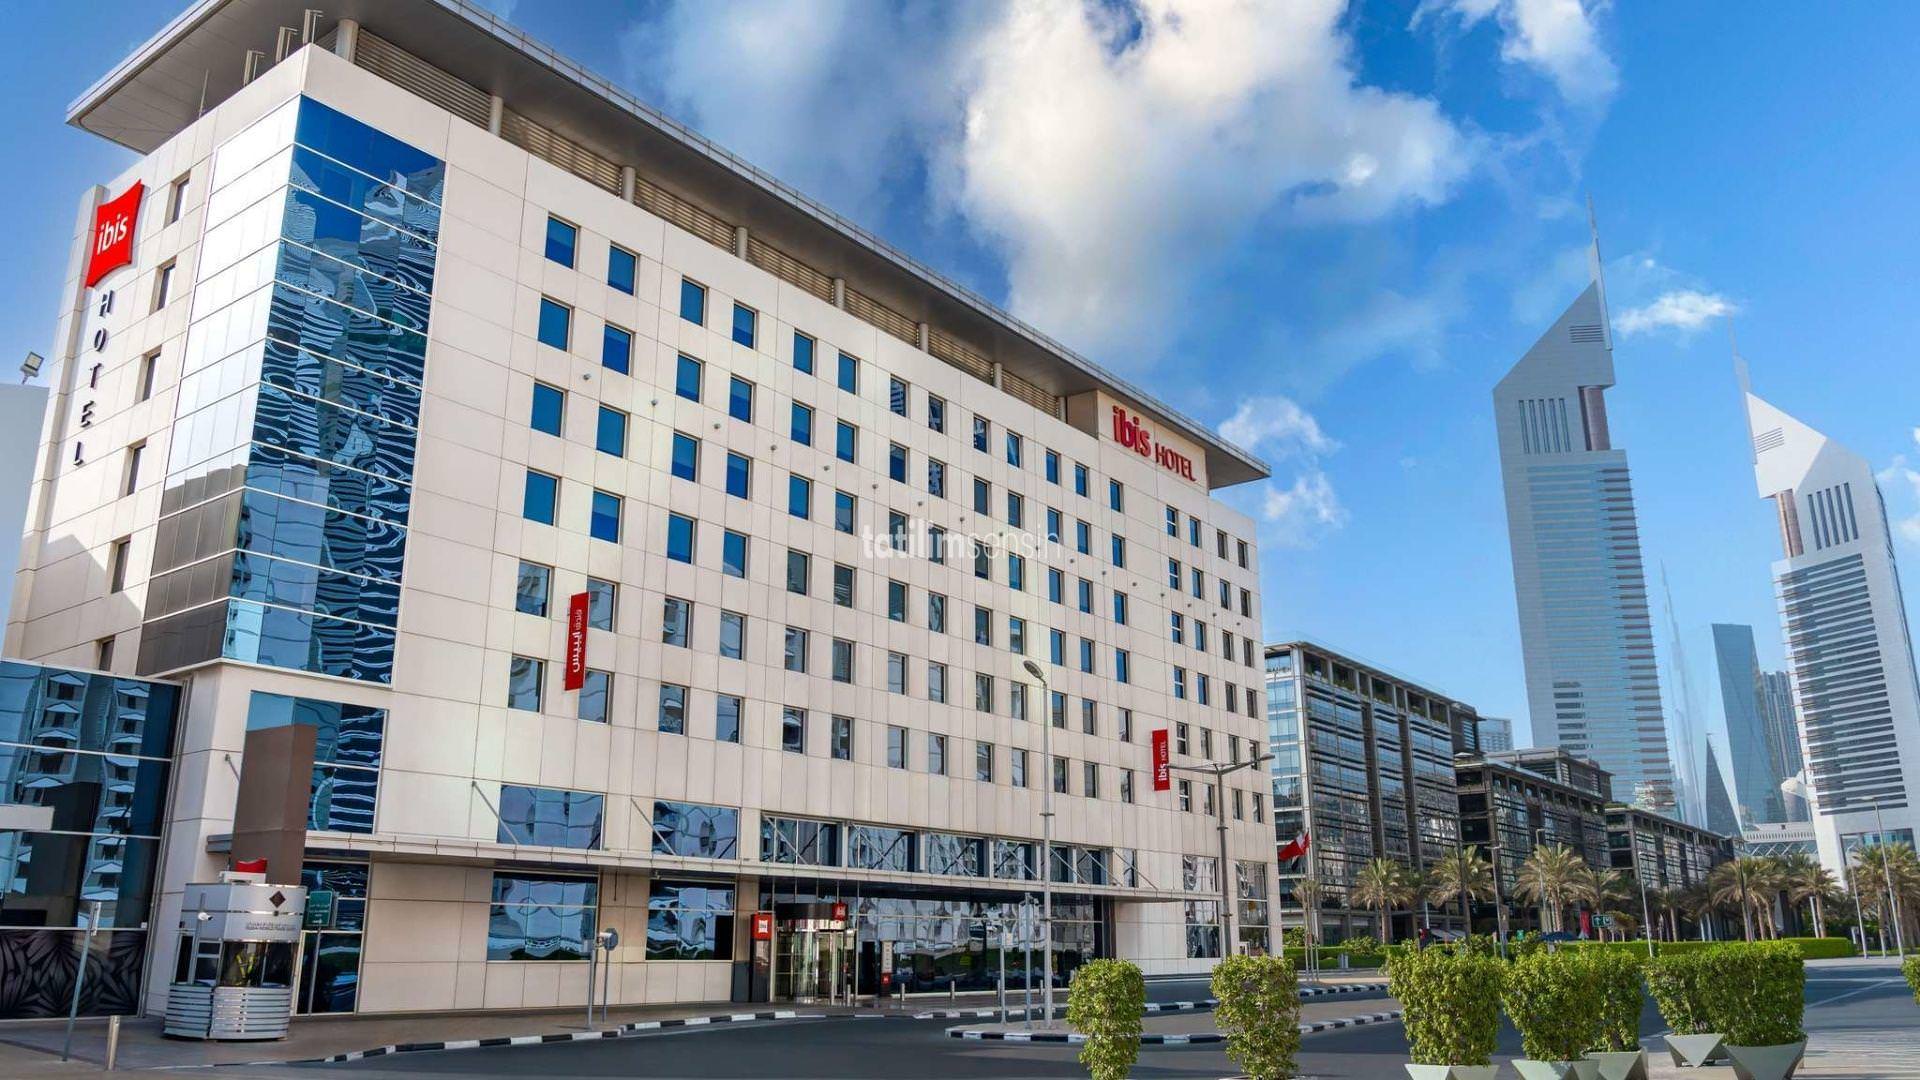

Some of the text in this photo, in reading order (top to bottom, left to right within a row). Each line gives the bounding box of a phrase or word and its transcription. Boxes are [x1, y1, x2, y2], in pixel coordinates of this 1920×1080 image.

[97, 213, 128, 256] ibis
[73, 289, 115, 468] HOTEL
[1112, 405, 1197, 482] ibis HOTEL
[1158, 763, 1168, 781] ibis
